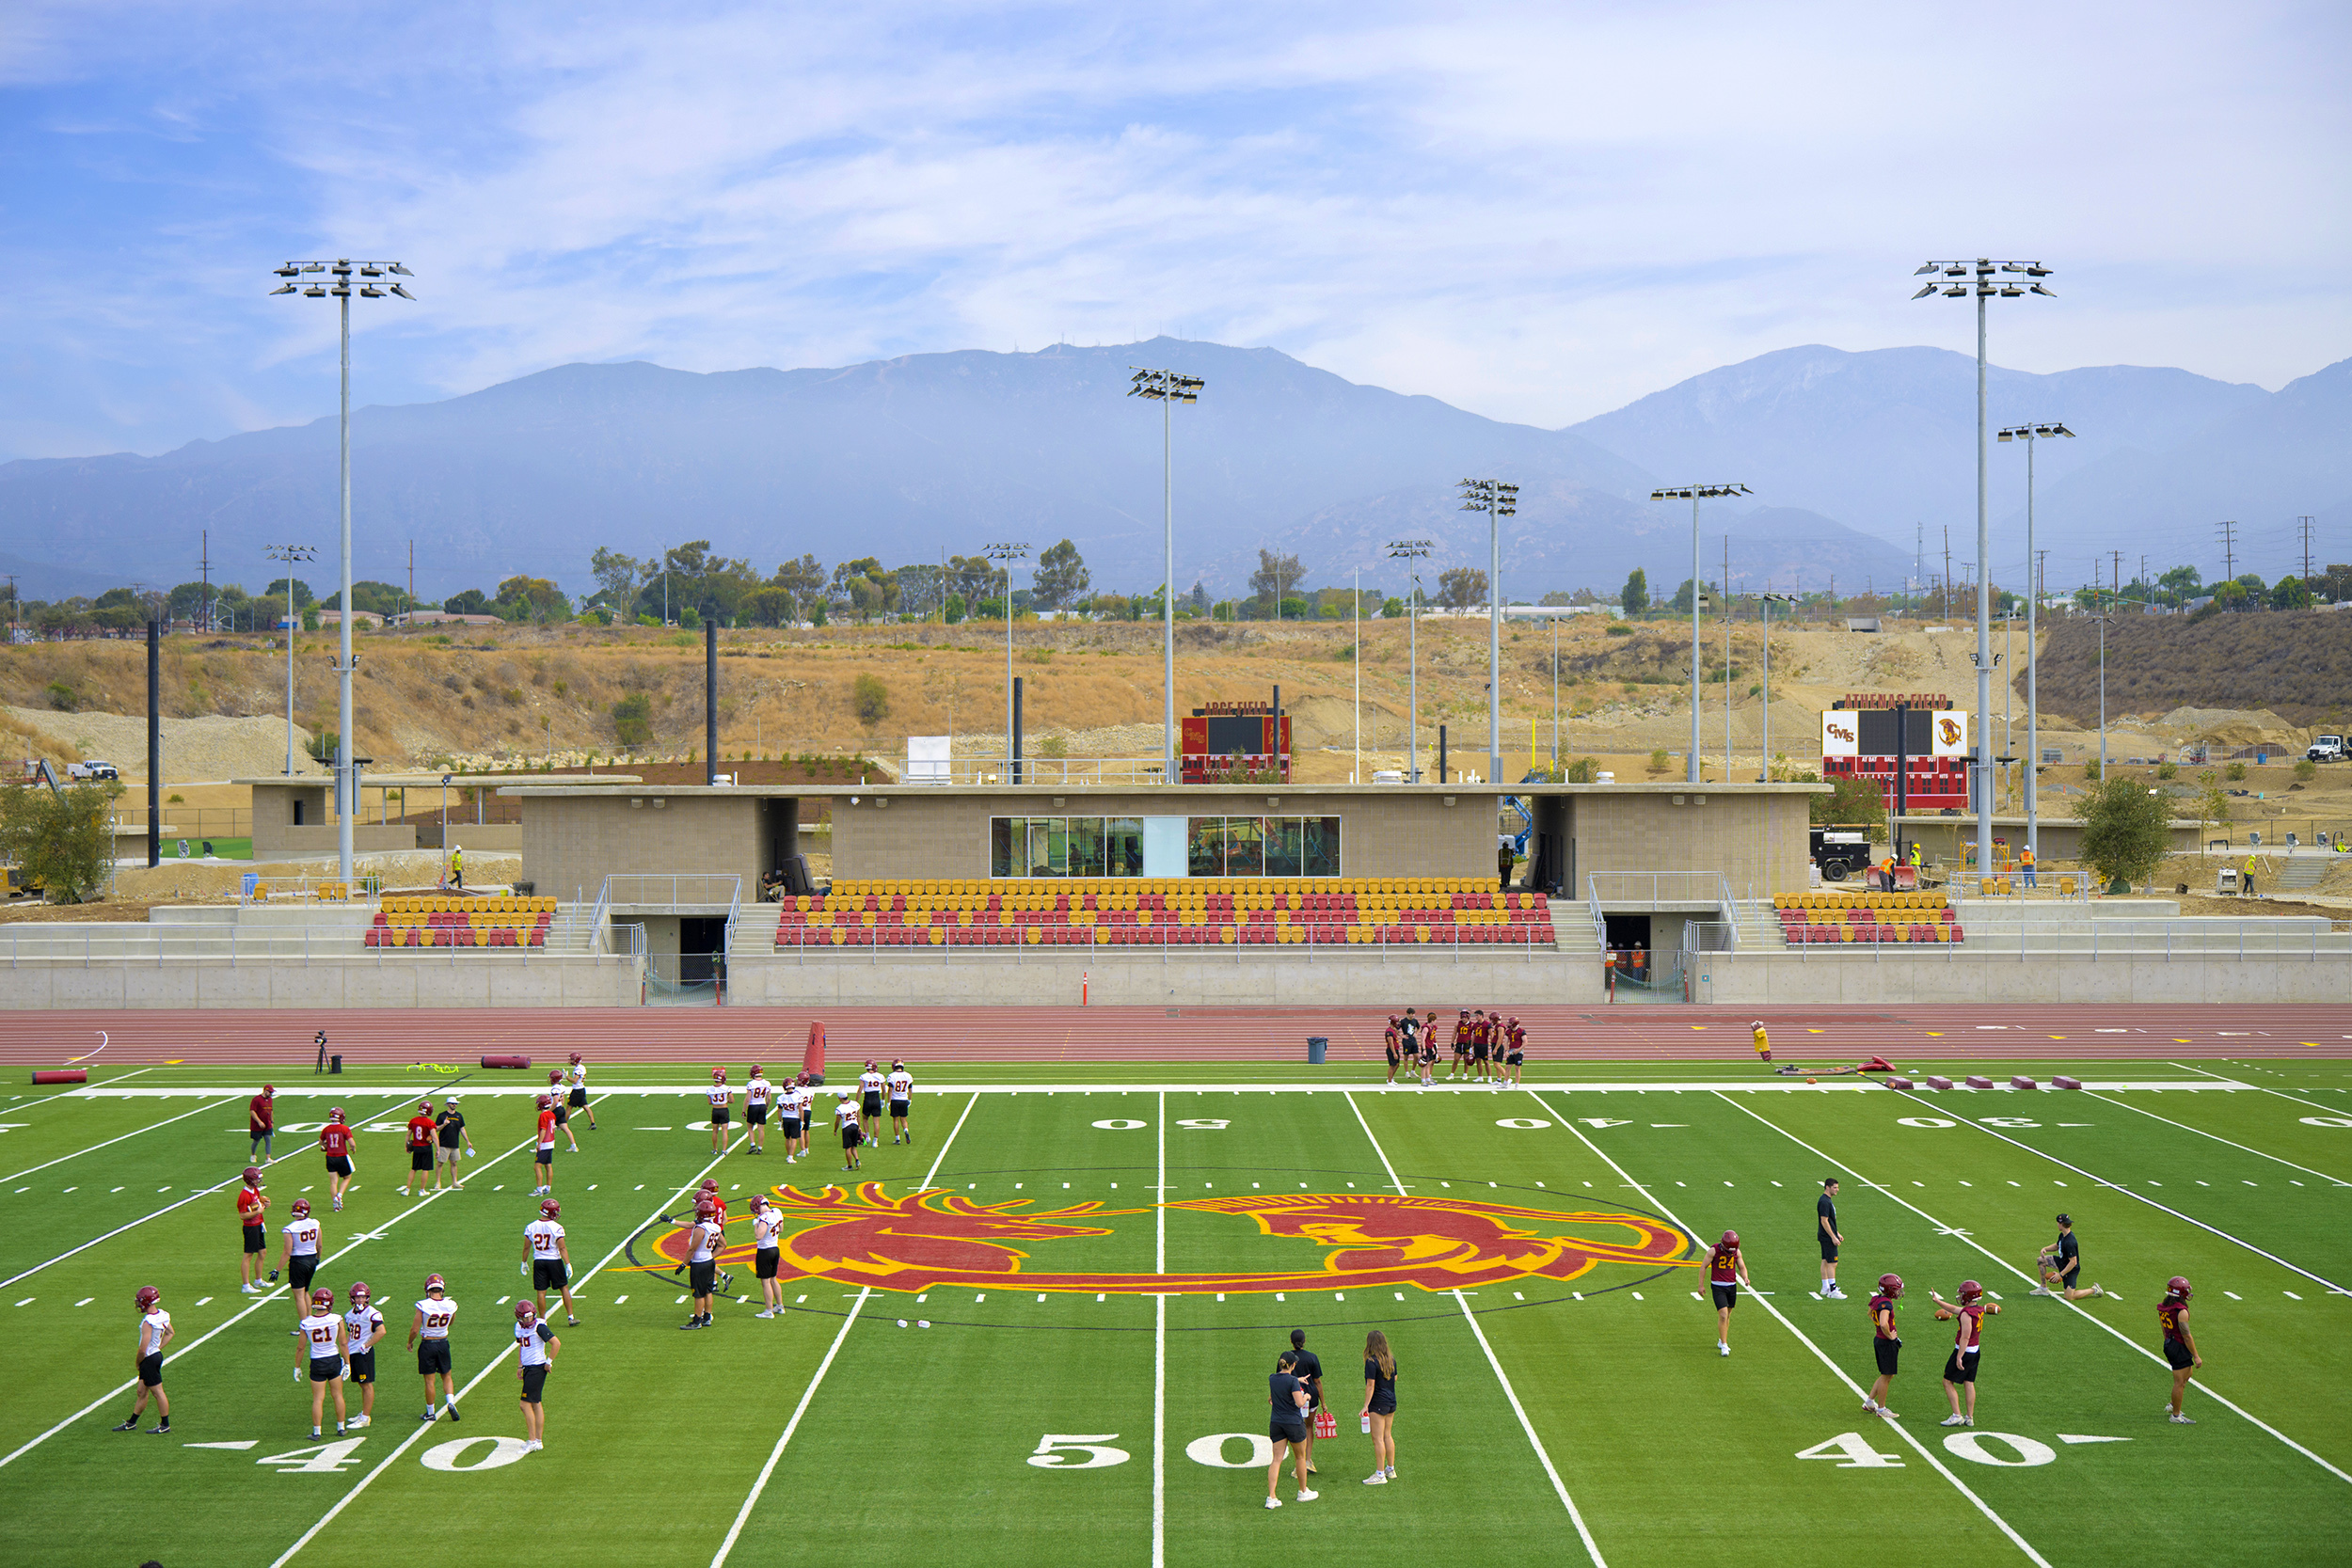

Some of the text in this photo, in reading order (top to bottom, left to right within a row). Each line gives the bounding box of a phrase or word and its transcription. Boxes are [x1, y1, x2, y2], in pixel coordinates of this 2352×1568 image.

[1237, 702, 1267, 715] FIELD
[1844, 694, 1947, 709] ATHENAS FIELD
[1827, 723, 1854, 742] CMS
[754, 1087, 767, 1099] 84
[895, 1081, 907, 1092] 87
[416, 1126, 423, 1140] 8
[533, 1233, 551, 1251] 27
[1718, 1255, 1735, 1270] 24
[426, 1313, 450, 1328] 26
[311, 1326, 332, 1343] 21
